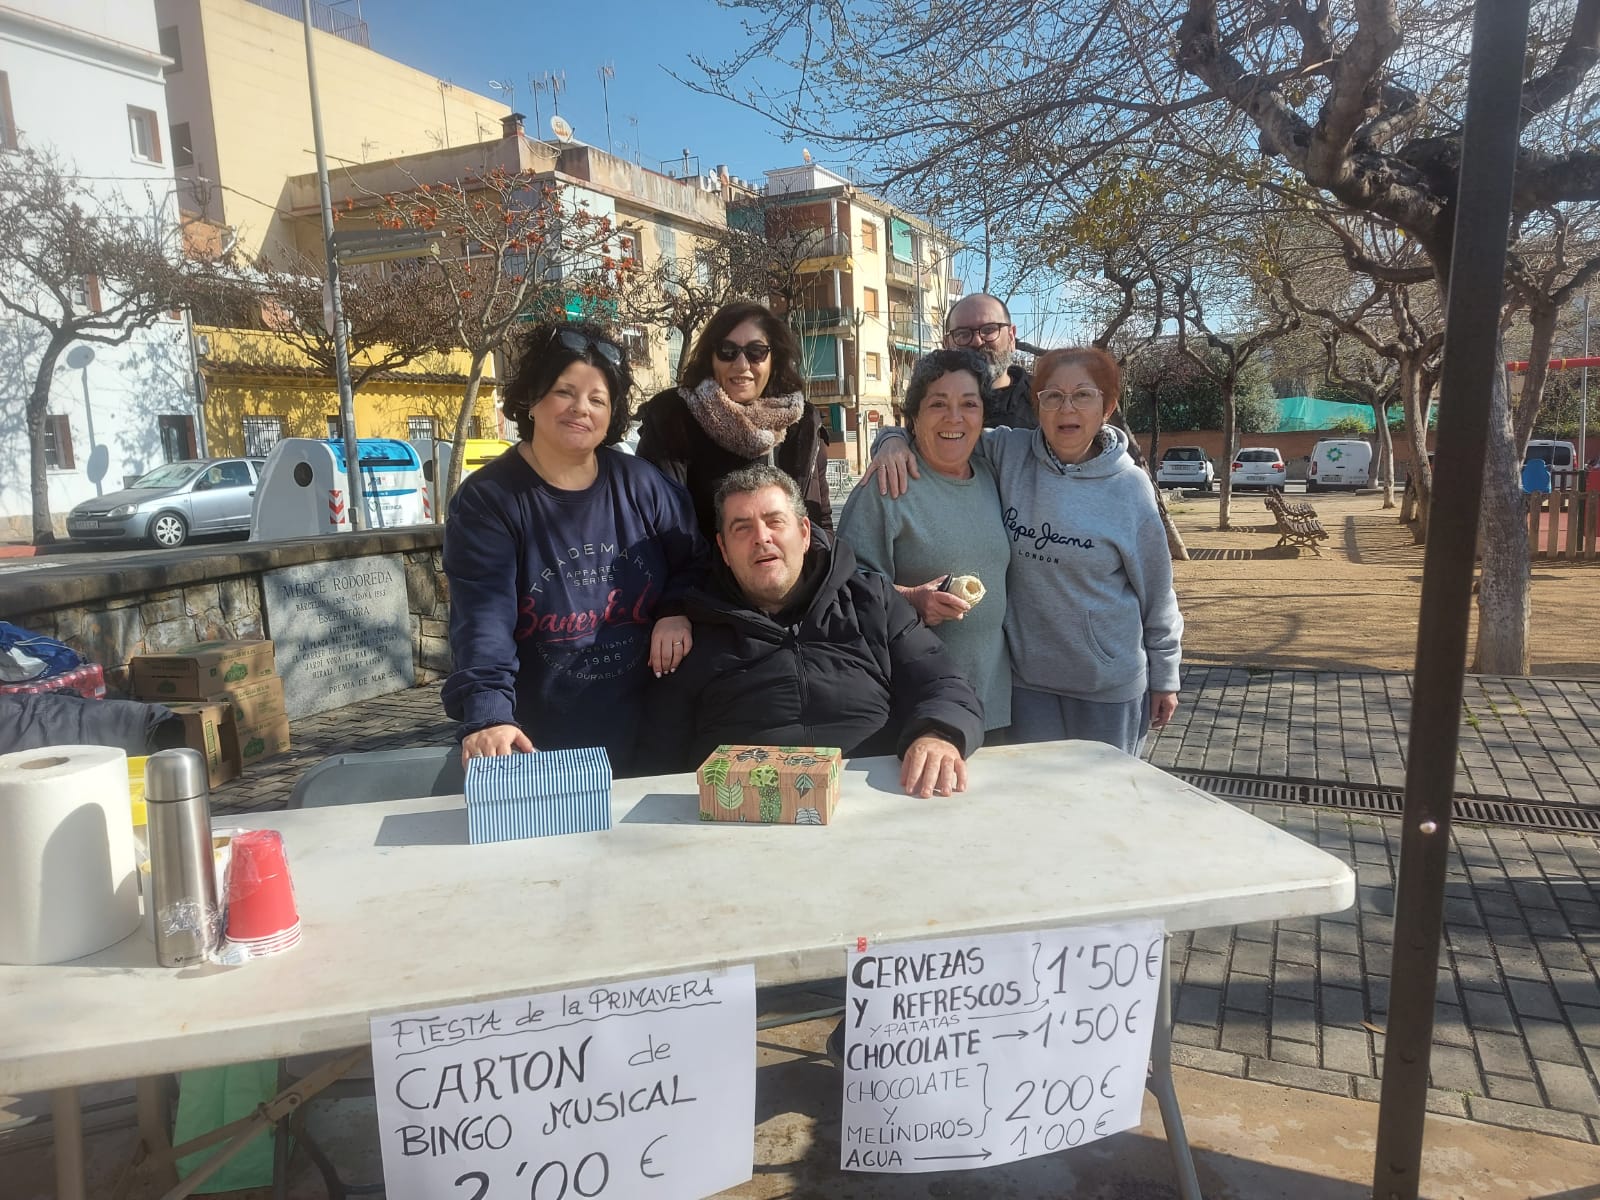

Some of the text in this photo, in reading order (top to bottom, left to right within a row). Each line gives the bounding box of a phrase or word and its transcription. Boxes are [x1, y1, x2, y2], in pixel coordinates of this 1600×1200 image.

[1003, 507, 1095, 550] Pepe Jeans
[1018, 549, 1060, 565] LONDON
[333, 571, 393, 592] RODOREDA
[573, 574, 615, 587] SERIES
[318, 606, 370, 624] ESCRIPTORA
[584, 653, 621, 666] 1986
[358, 677, 368, 687] DE
[371, 672, 386, 682] MAR
[851, 947, 985, 990] CERVEZAS
[390, 977, 715, 1047] FIESTA de la PRIMAVERA
[851, 981, 1022, 1029] Y REFRESCOS
[869, 1014, 961, 1038] Y PATATAS
[846, 1029, 982, 1071] CHOCOLATE
[395, 1033, 672, 1110] CARTON de
[846, 1067, 970, 1104] CHOCOLATE
[394, 1074, 697, 1157] BINGO MUSICAL
[883, 1106, 899, 1125] Y
[640, 1134, 669, 1179] €
[845, 1148, 903, 1168] AGUA
